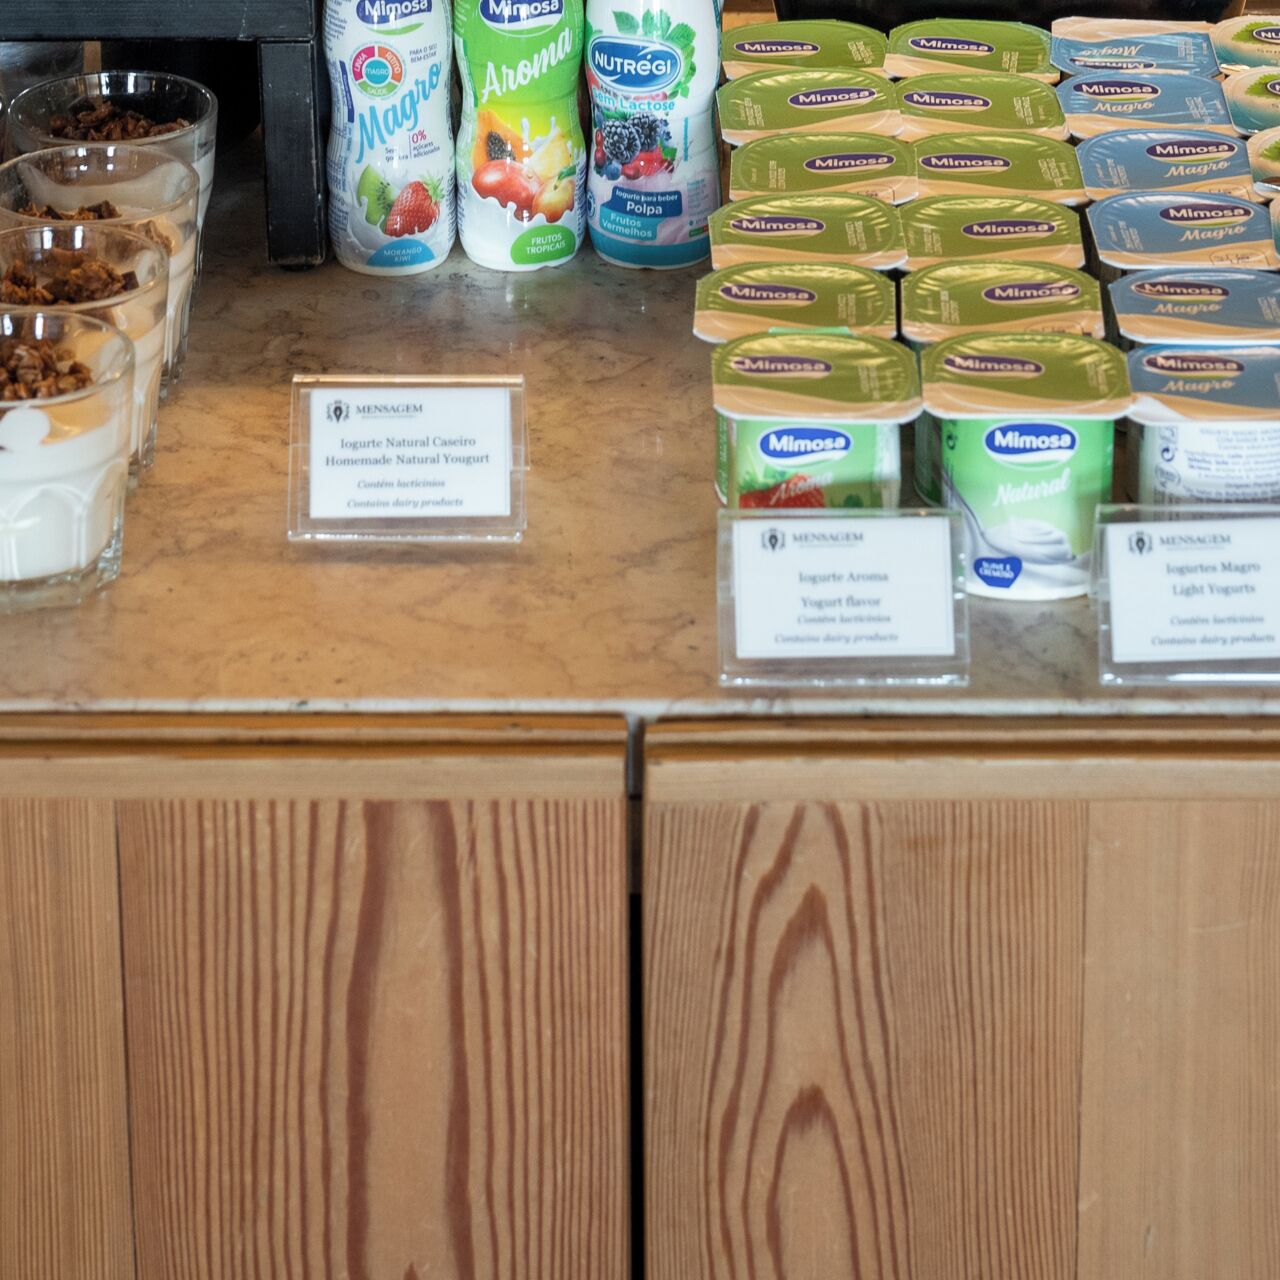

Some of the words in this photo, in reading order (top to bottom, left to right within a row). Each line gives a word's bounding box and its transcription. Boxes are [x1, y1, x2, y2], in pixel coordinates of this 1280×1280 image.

[920, 39, 988, 51] Mimosa
[481, 27, 572, 104] Aroma
[1082, 84, 1153, 94] Mimosa
[799, 90, 869, 103] Mimosa
[913, 94, 983, 106] Mimosa
[620, 99, 675, 111] Lactose
[1093, 103, 1155, 113] Magro
[355, 63, 441, 164] Magro
[412, 130, 426, 144] 0%
[1156, 144, 1229, 155] Mimosa
[816, 156, 888, 168] Mimosa
[931, 157, 1004, 167] Mimosa
[1164, 161, 1230, 178] Magro
[616, 189, 640, 201] Iogurte
[627, 201, 662, 216] Polpa
[1169, 208, 1245, 217] Mimosa
[611, 213, 641, 227] Frutos
[742, 220, 818, 229] Mimosa
[602, 220, 652, 237] Vermelhos
[972, 224, 1049, 233] Mimosa
[1179, 226, 1247, 242] Magro
[532, 232, 562, 245] FRUTOS
[384, 247, 422, 256] MORANGO
[526, 240, 566, 254] TROPICAIS
[731, 287, 809, 299] Mimosa
[995, 287, 1075, 298] Mimosa
[1145, 284, 1223, 294] Mimosa
[1153, 304, 1222, 314] Magro
[743, 358, 827, 373] Mimosa
[955, 357, 1037, 372] Mimosa
[1156, 357, 1238, 370] Mimosa
[1161, 379, 1236, 393] Magro
[356, 404, 423, 414] MENSAGEM
[341, 438, 383, 451] Iogurte
[386, 437, 430, 448] Natural
[433, 436, 476, 447] Caseiro
[768, 432, 846, 453] Mimosa
[994, 429, 1071, 449] Mimosa
[325, 455, 392, 467] Homemade
[397, 454, 440, 465] Natural
[443, 453, 489, 467] Yougurt
[357, 479, 394, 489] Contém
[770, 472, 835, 506] Aroma
[991, 467, 1072, 508] Natural
[347, 499, 390, 509] Contains
[392, 498, 419, 510] dairy
[421, 498, 463, 508] products
[792, 532, 864, 543] MENSAGEM
[1159, 534, 1231, 545] MENSAGEM
[1167, 562, 1217, 576] Iogurtes
[1221, 561, 1260, 575] Magro
[799, 572, 842, 586] Iogurte
[850, 572, 889, 582] Aroma
[1173, 583, 1204, 597] Light
[1209, 582, 1256, 596] Yogurts
[801, 597, 842, 610] Yogurt
[846, 596, 881, 607] flavor
[775, 633, 820, 644] Contains
[823, 632, 850, 645] dairy
[853, 632, 898, 644] products
[1230, 633, 1275, 644] products
